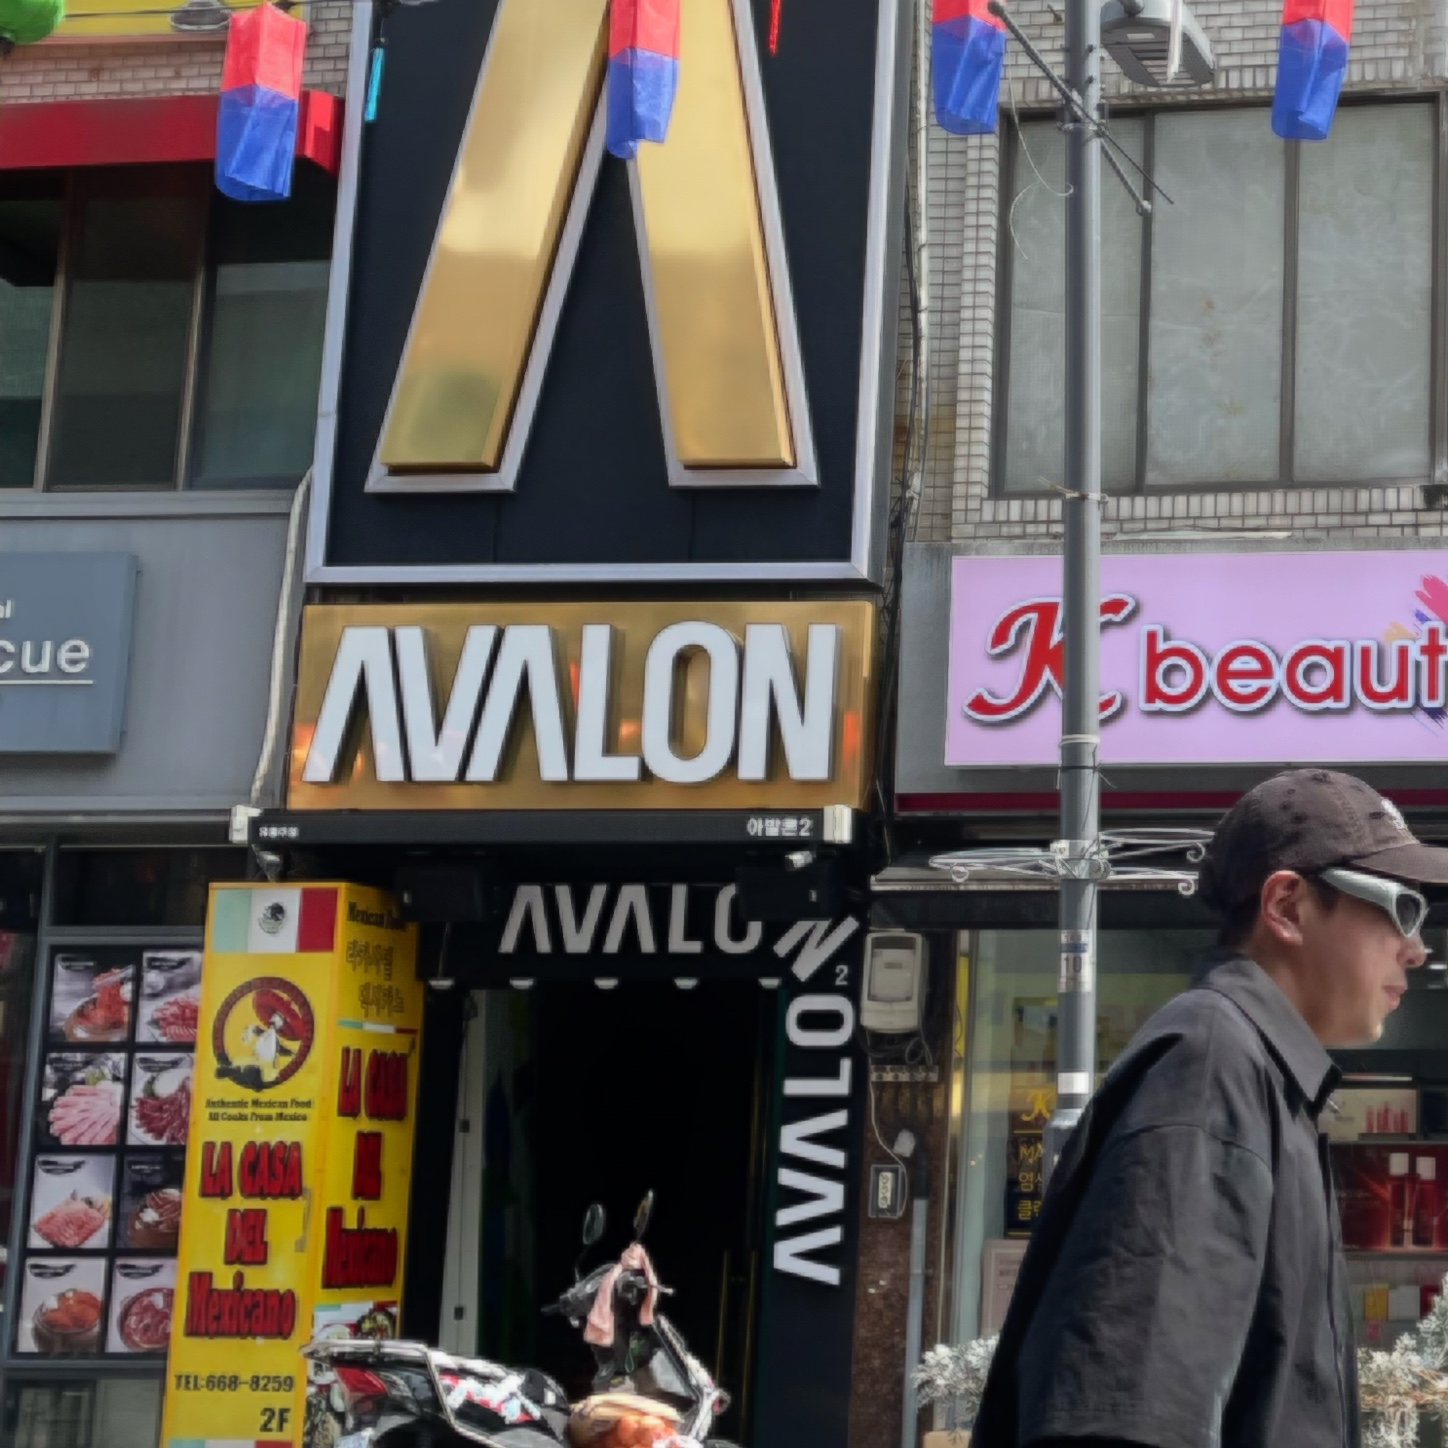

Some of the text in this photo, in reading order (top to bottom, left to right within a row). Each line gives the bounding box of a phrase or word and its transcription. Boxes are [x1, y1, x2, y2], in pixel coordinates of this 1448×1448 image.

[963, 593, 1136, 722] K
[302, 620, 838, 784] AVALON
[221, 1112, 249, 1121] Cooks
[250, 1112, 273, 1121] From
[275, 1112, 308, 1121] Mexico
[251, 1098, 289, 1109] Mexican
[290, 1098, 312, 1109] Food
[199, 1140, 303, 1200] LA CASA
[224, 1208, 268, 1265] DEL
[184, 1270, 296, 1339] Mexicano
[175, 1374, 294, 1393] TEL:668-8259
[259, 1407, 291, 1433] 2F
